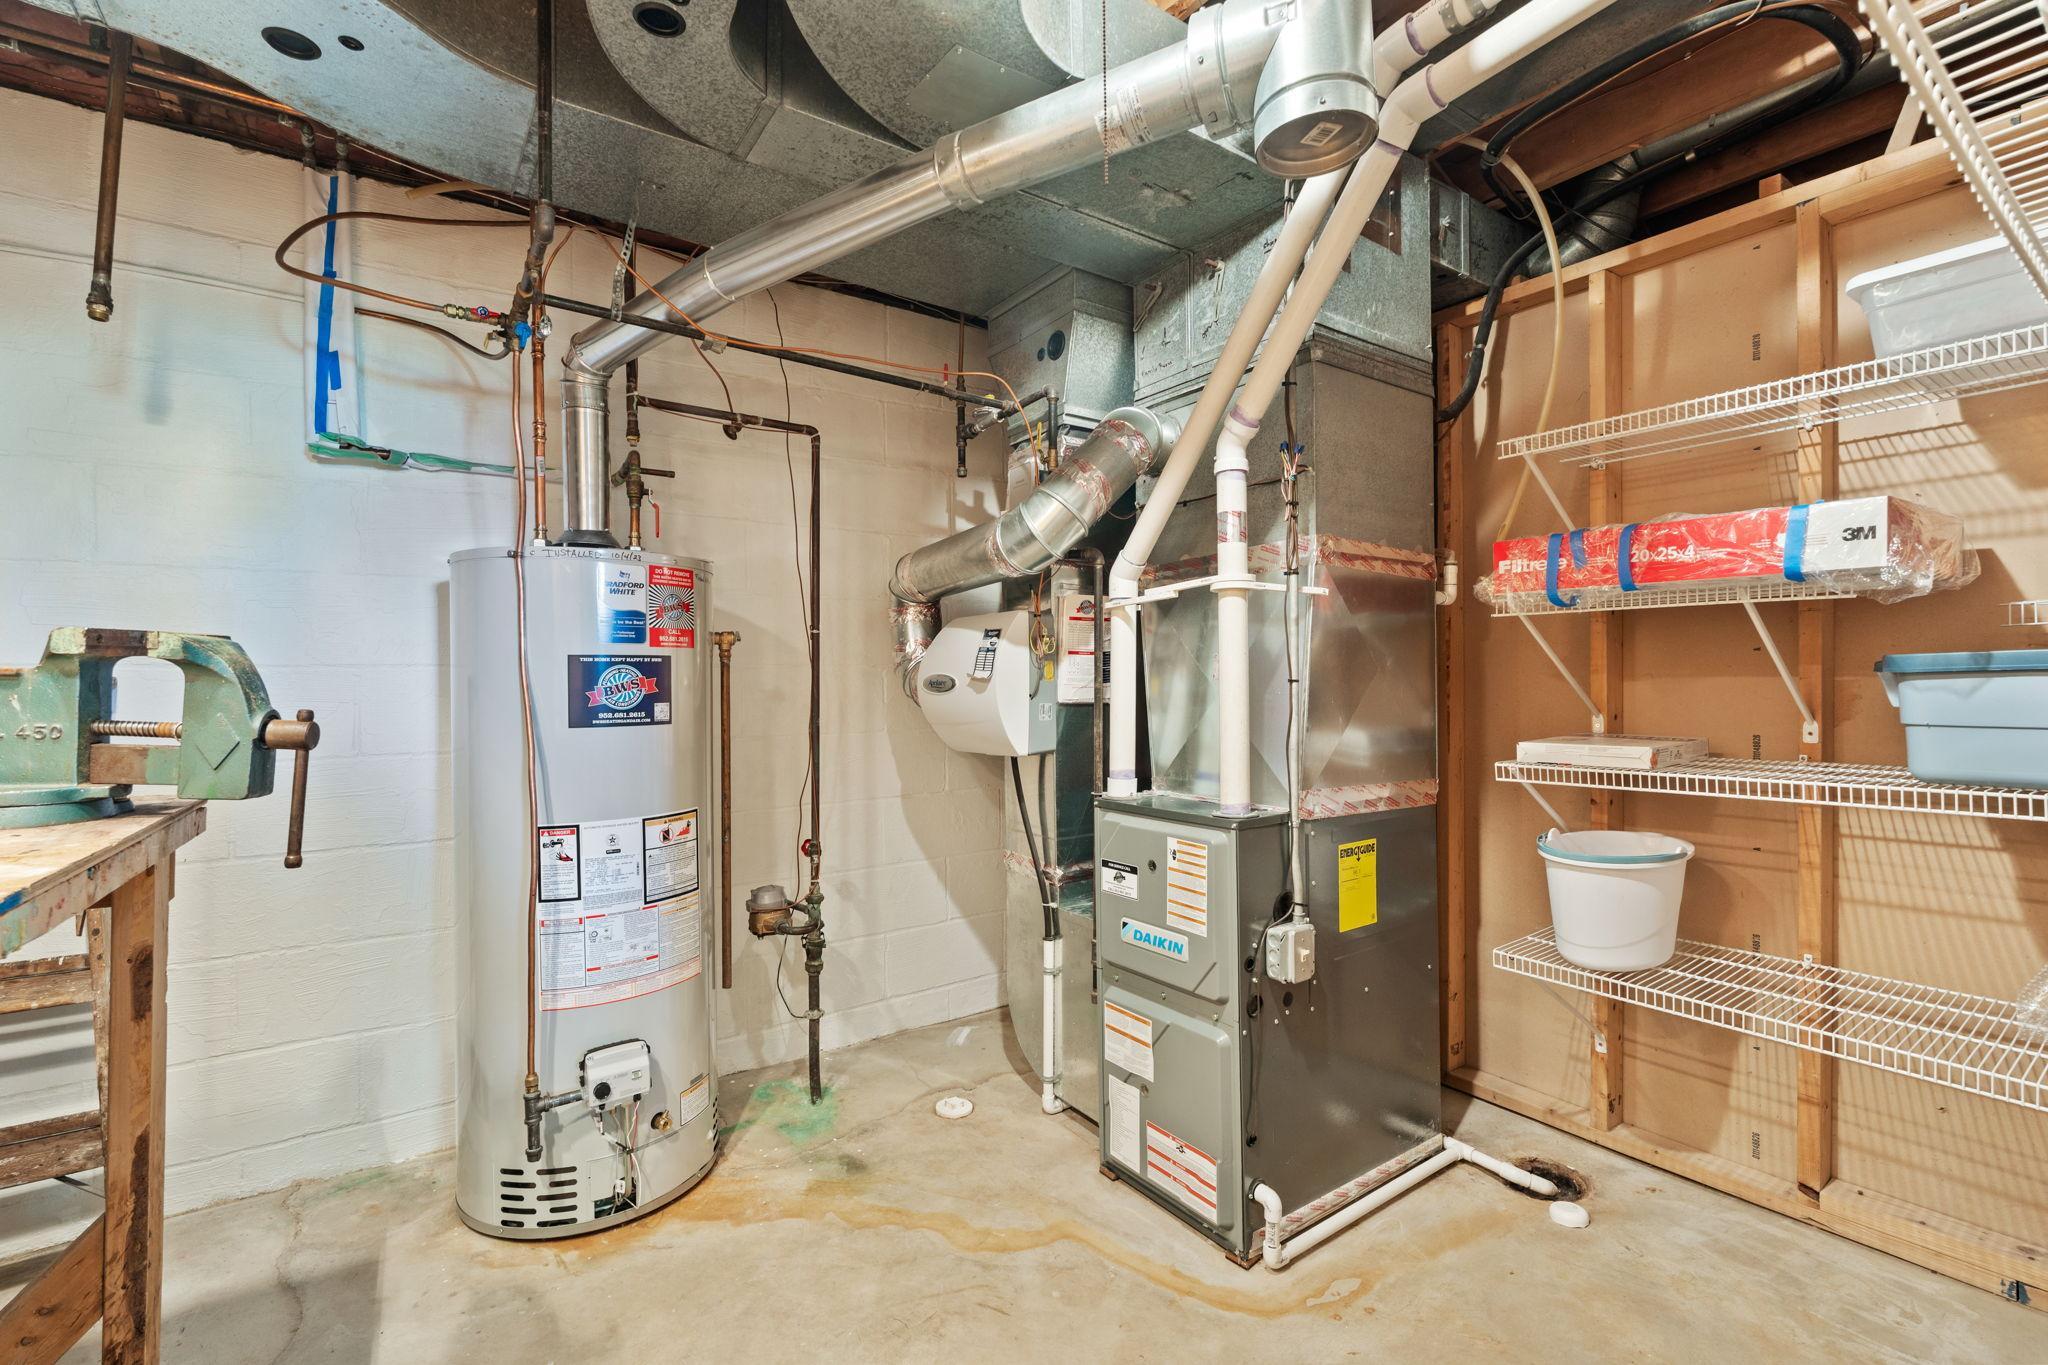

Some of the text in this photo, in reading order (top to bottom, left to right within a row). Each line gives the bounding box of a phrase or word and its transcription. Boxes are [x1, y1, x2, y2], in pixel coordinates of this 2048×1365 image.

[1842, 525, 1877, 542] 3M
[541, 549, 602, 559] INSTALLED
[1498, 557, 1568, 574] Filtree
[604, 678, 639, 697] BWS
[598, 711, 646, 719] 952.681.2615
[15, 723, 64, 742] 450
[1133, 928, 1184, 956] DAIKIN
